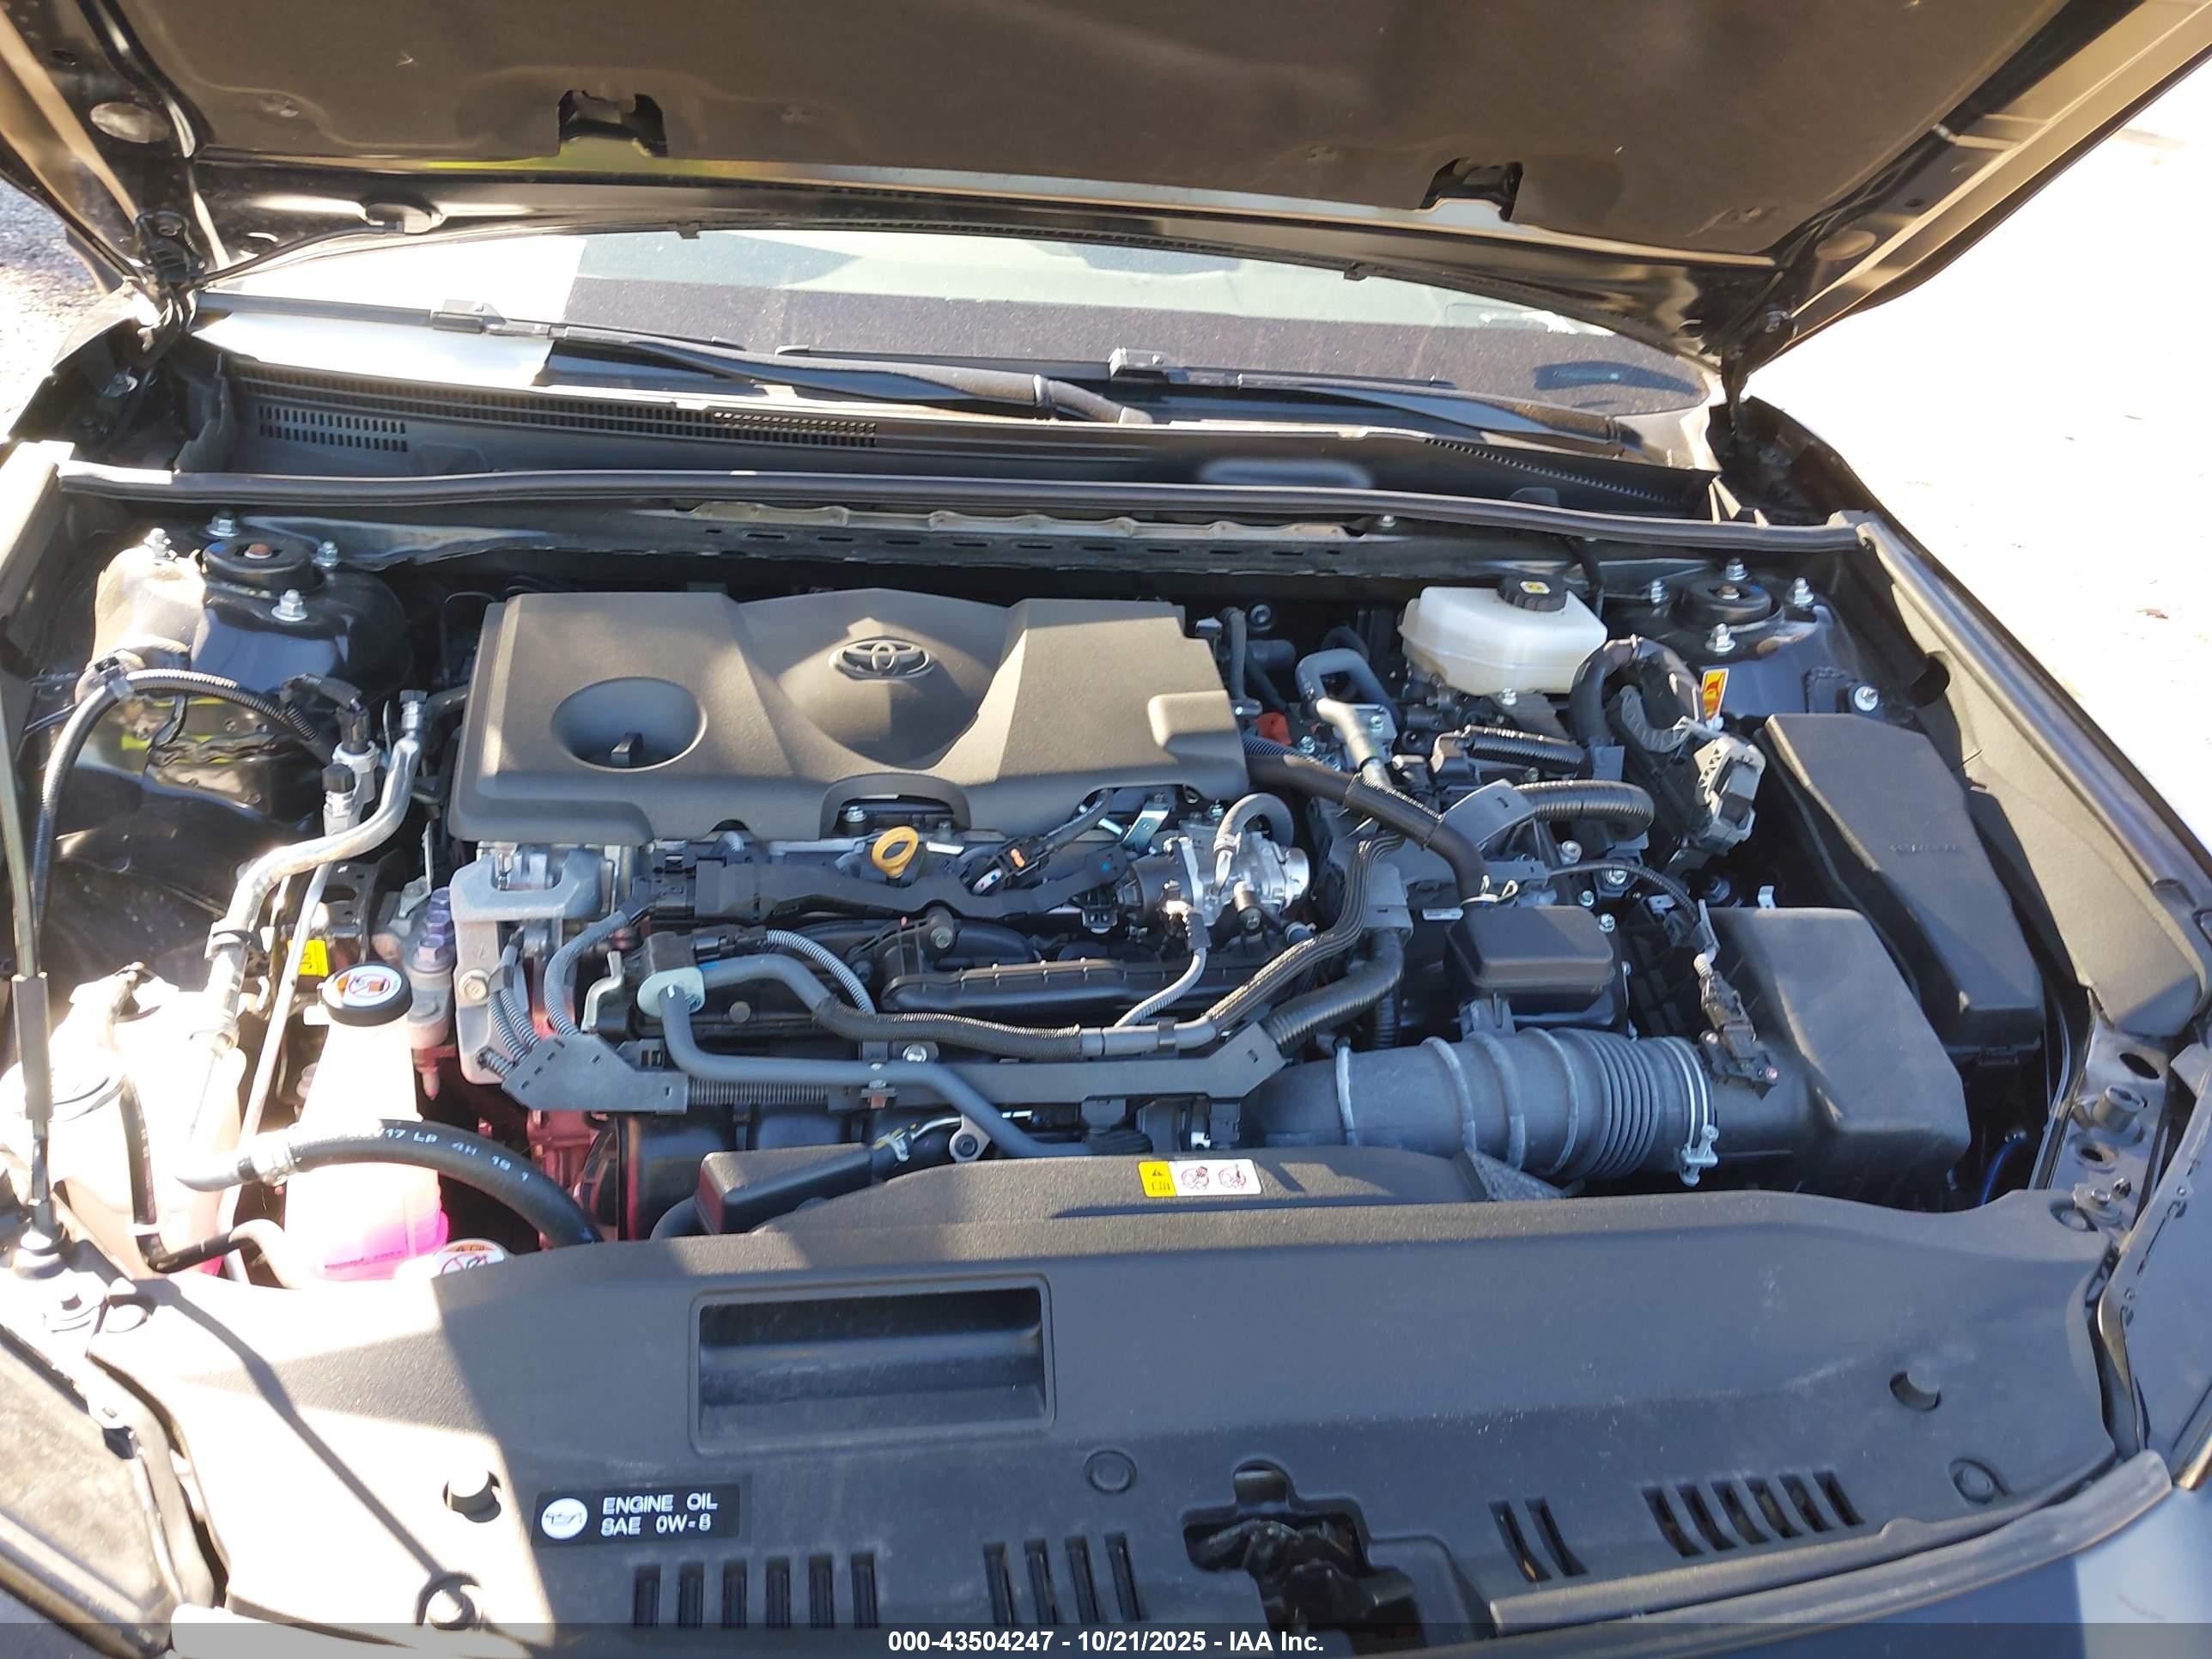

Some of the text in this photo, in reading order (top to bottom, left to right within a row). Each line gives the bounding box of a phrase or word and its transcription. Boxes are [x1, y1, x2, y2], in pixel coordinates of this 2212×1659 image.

[602, 1492, 719, 1515] ENGINE OIL
[600, 1513, 711, 1537] SAE 0W-8
